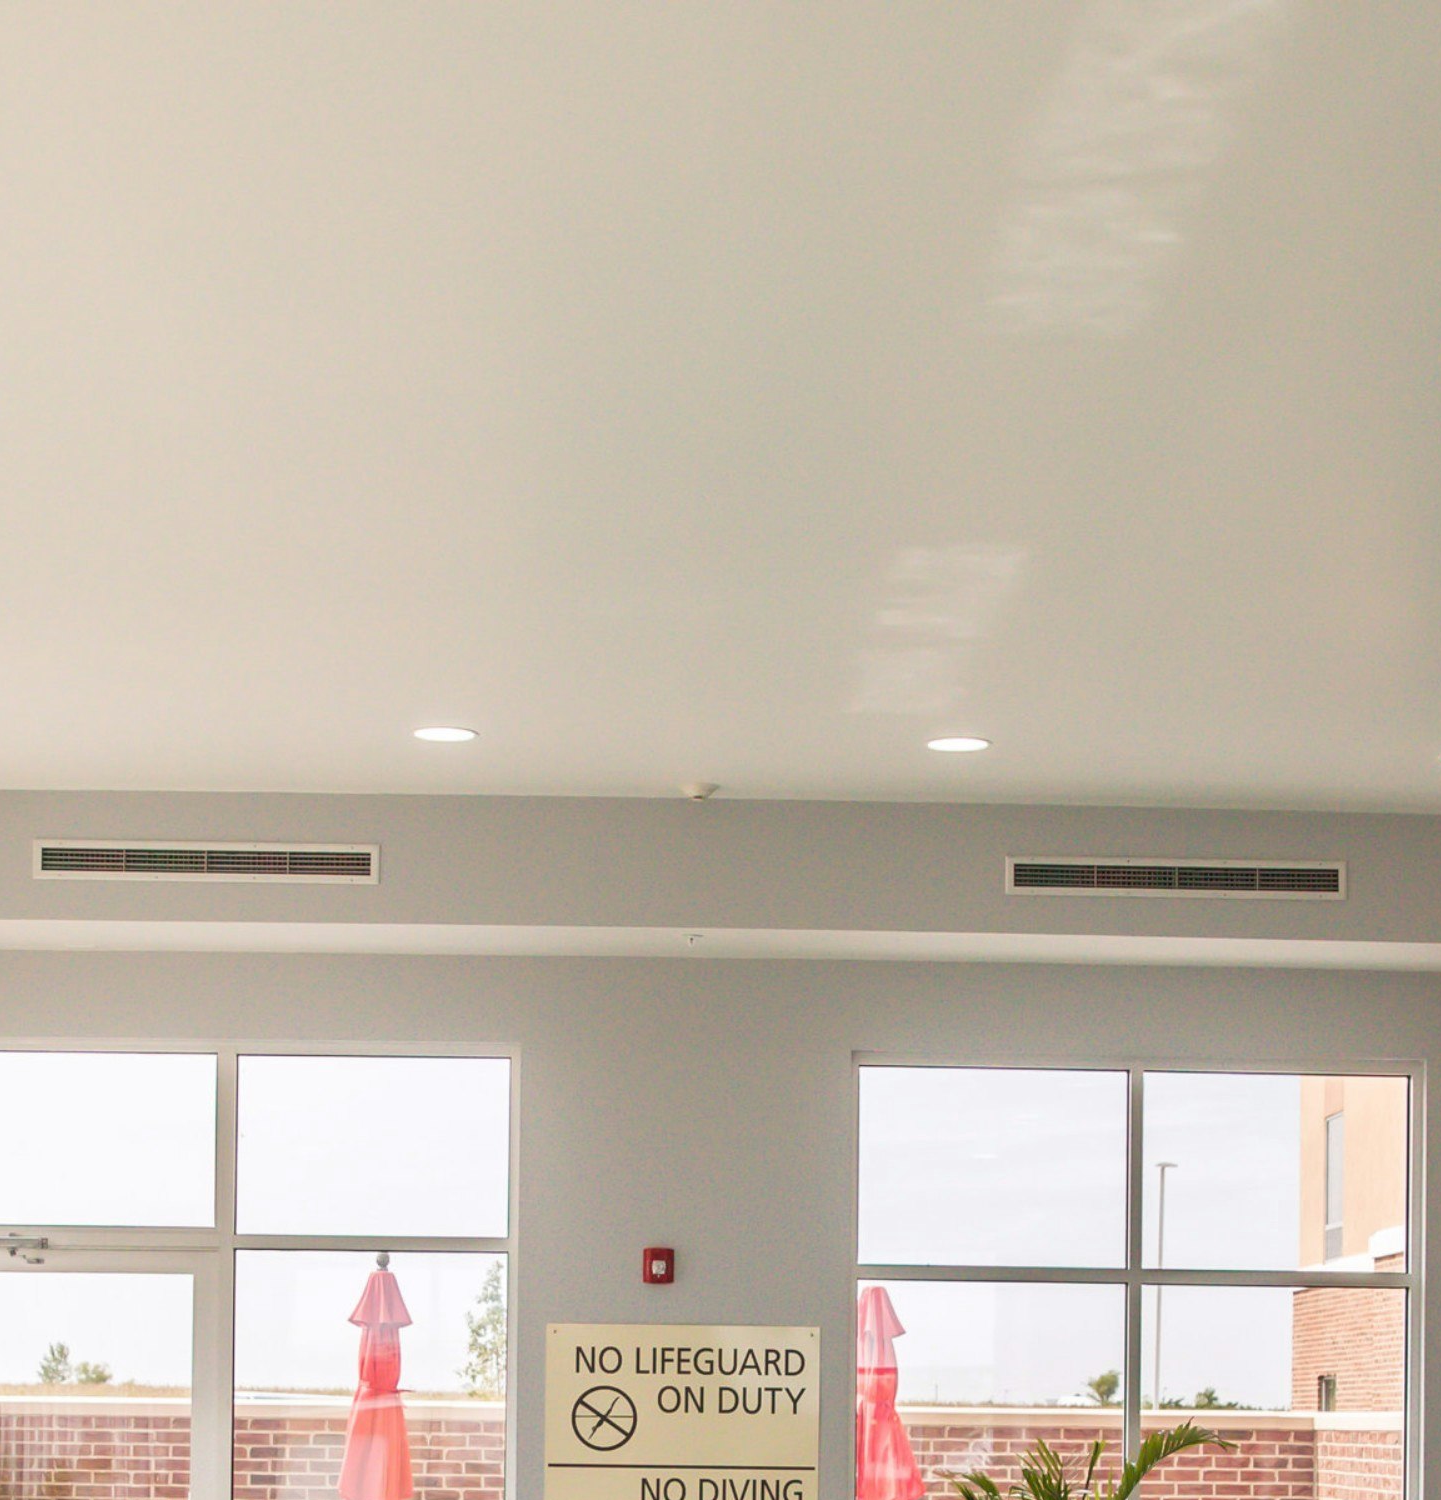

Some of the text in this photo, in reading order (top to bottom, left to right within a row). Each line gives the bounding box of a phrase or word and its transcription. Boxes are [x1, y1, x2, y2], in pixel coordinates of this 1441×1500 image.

[575, 1345, 806, 1376] NO LIFEGUARD
[657, 1385, 806, 1415] ON DUTY
